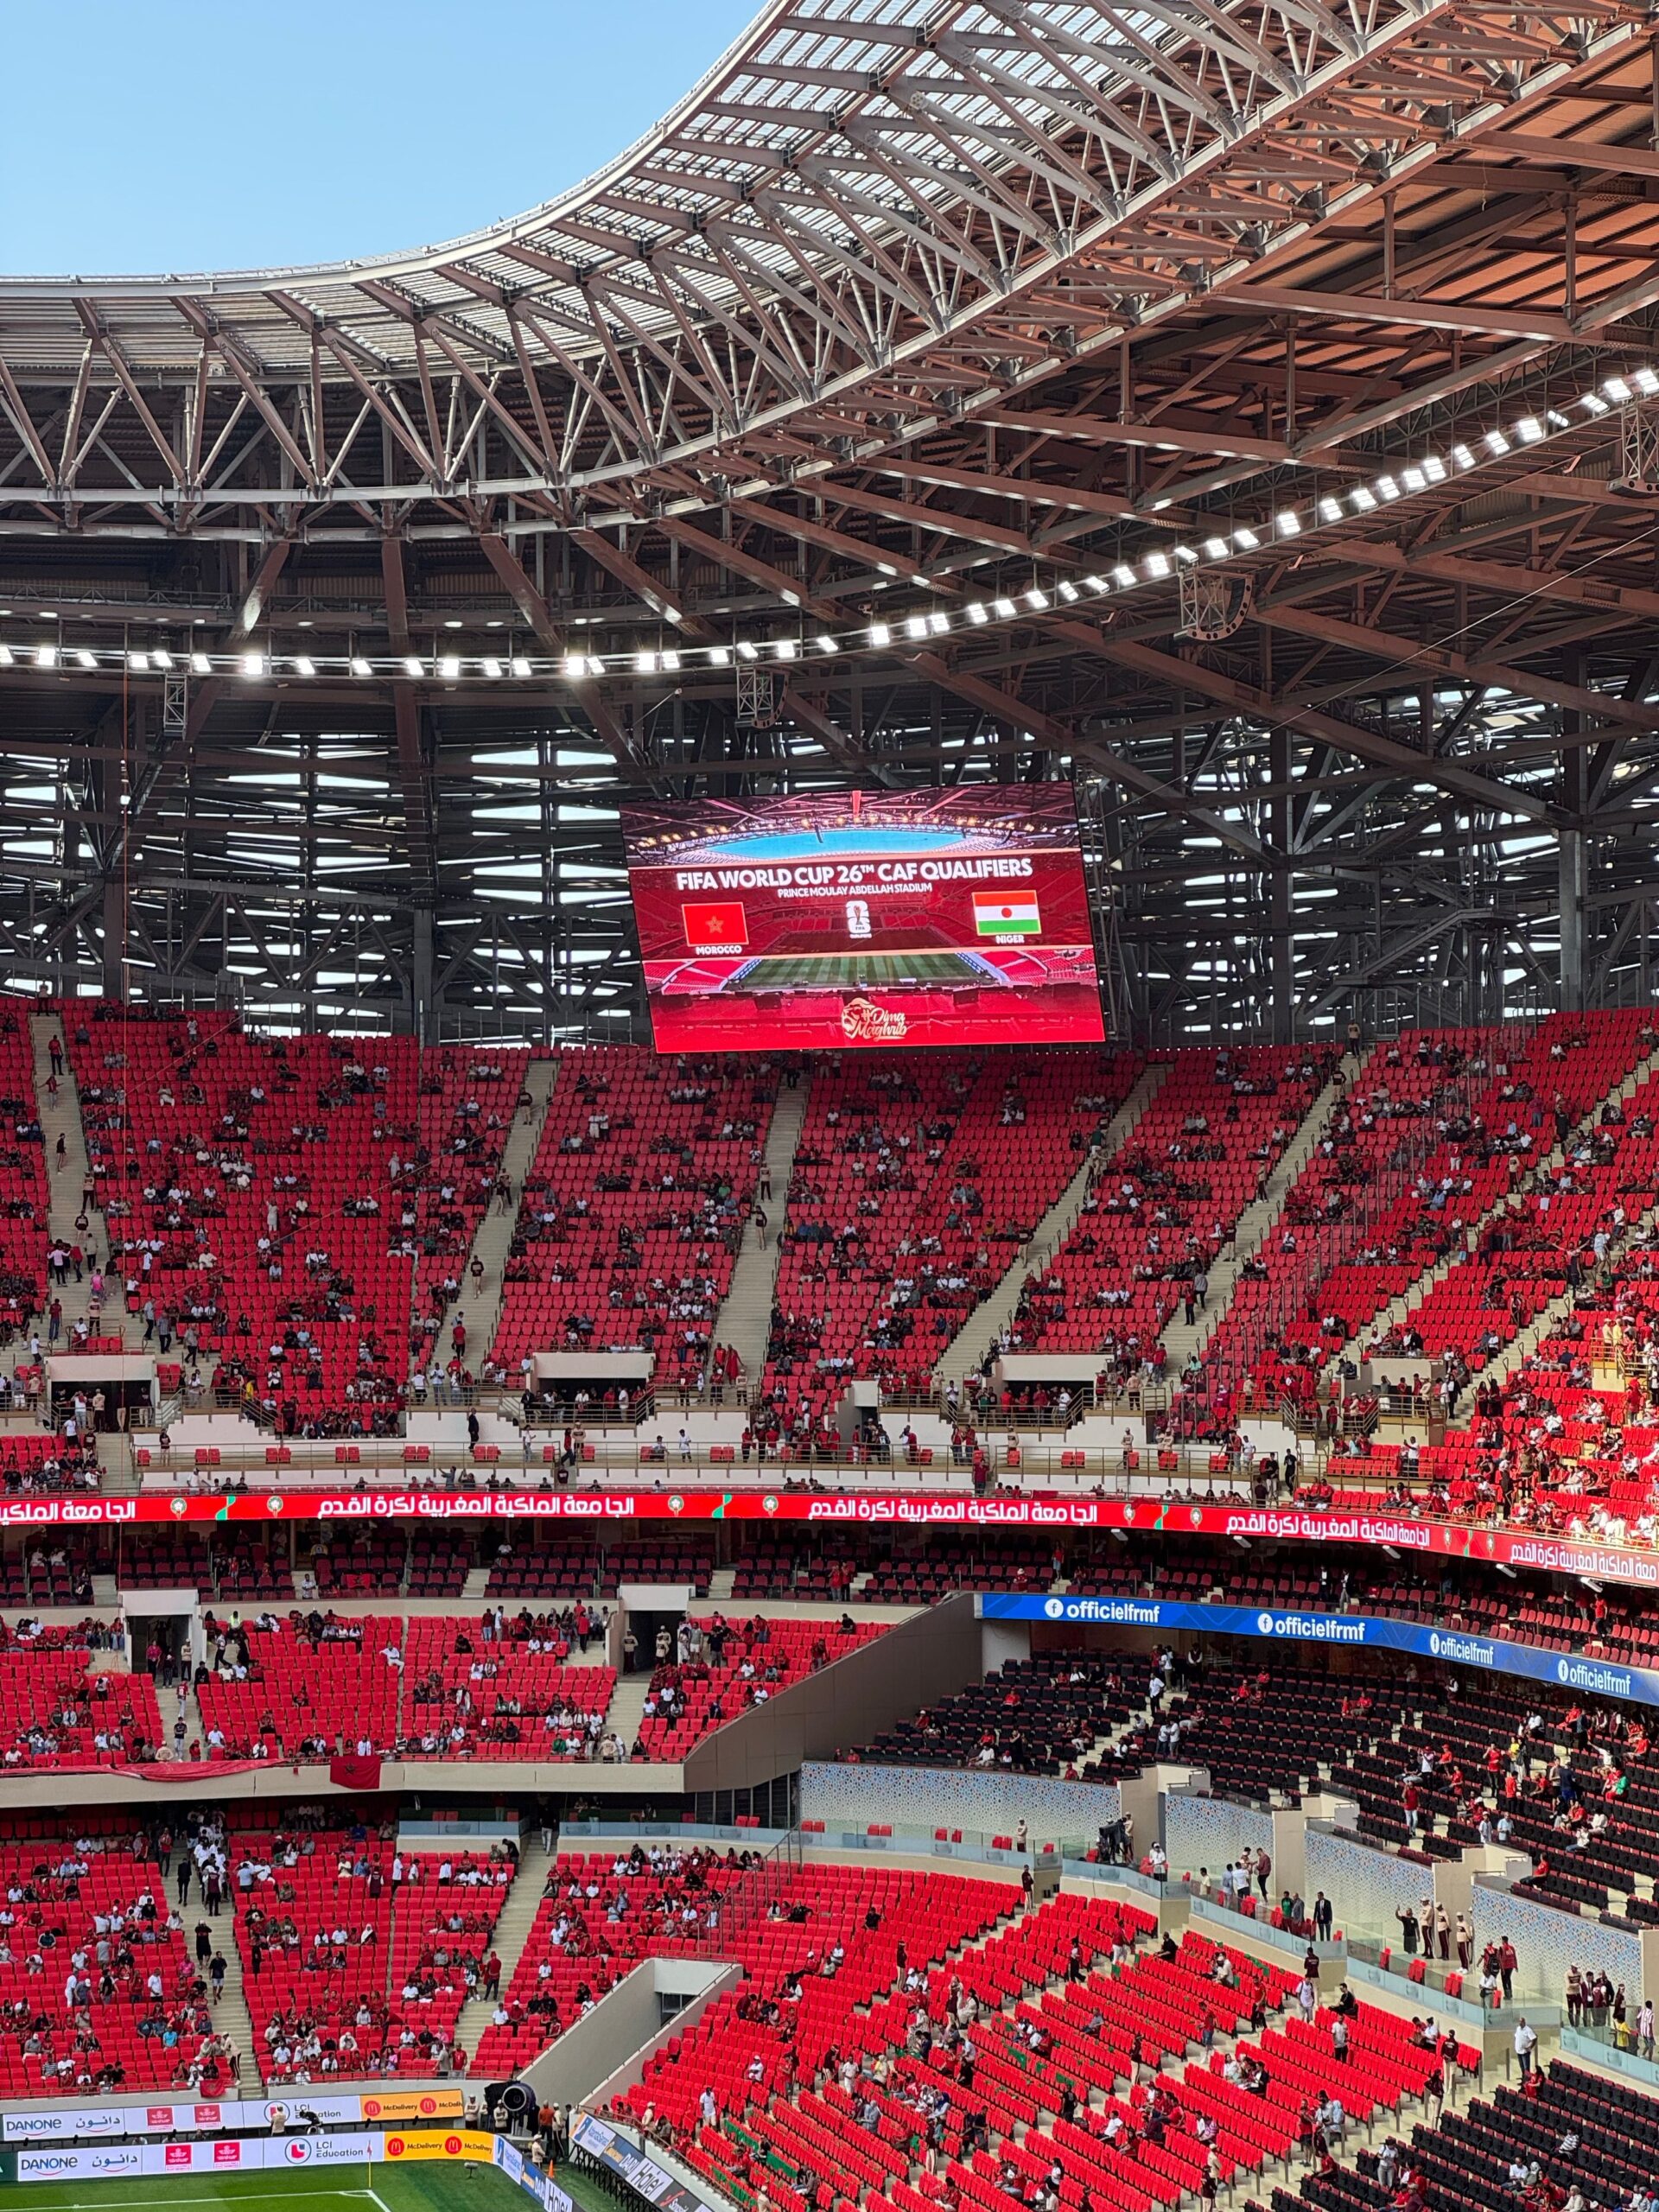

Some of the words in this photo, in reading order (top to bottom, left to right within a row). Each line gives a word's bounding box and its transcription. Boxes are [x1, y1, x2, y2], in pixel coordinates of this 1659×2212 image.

[677, 870, 717, 891] FIFA
[718, 868, 792, 888] WORLD
[794, 867, 835, 886] CUP
[878, 862, 918, 881] CAF
[920, 858, 1033, 880] QUALIFIERS
[778, 887, 810, 899] PRINCE
[810, 886, 848, 896] MOULAY
[849, 884, 893, 894] ABDELLAH
[894, 882, 932, 893] STADIUM
[696, 945, 742, 955] MOROCCO
[995, 935, 1025, 944] NIGER
[0, 1503, 58, 1526] الملكي
[318, 1496, 371, 1519] القدم
[374, 1495, 415, 1518] لكرة
[418, 1495, 491, 1517] المغربية
[495, 1495, 560, 1518] الملكية
[808, 1499, 855, 1520] القدم
[859, 1499, 894, 1522] لكرة
[898, 1498, 964, 1522] المغربية
[968, 1500, 1028, 1524] الملكية
[1227, 1514, 1266, 1535] القدم
[1268, 1514, 1299, 1537] لكرة
[1301, 1515, 1357, 1540] المغربية
[1361, 1519, 1397, 1543] الملكية
[1510, 1541, 1536, 1564] القدم
[1538, 1543, 1558, 1568] لكرة
[1560, 1546, 1597, 1573] المغربية
[1066, 1601, 1160, 1623] officielfrmf
[1275, 1616, 1365, 1640] officielfrmf
[1441, 1637, 1494, 1665] officielfrmf
[1570, 1667, 1631, 1695] officielfrmf
[7, 2119, 62, 2131] DANONE
[295, 2111, 340, 2120] Eation
[315, 2148, 363, 2158] Education
[316, 2141, 332, 2150] LCI
[464, 2143, 493, 2154] McDelivery
[22, 2157, 78, 2170] DANONE
[631, 2163, 664, 2197] Haier
